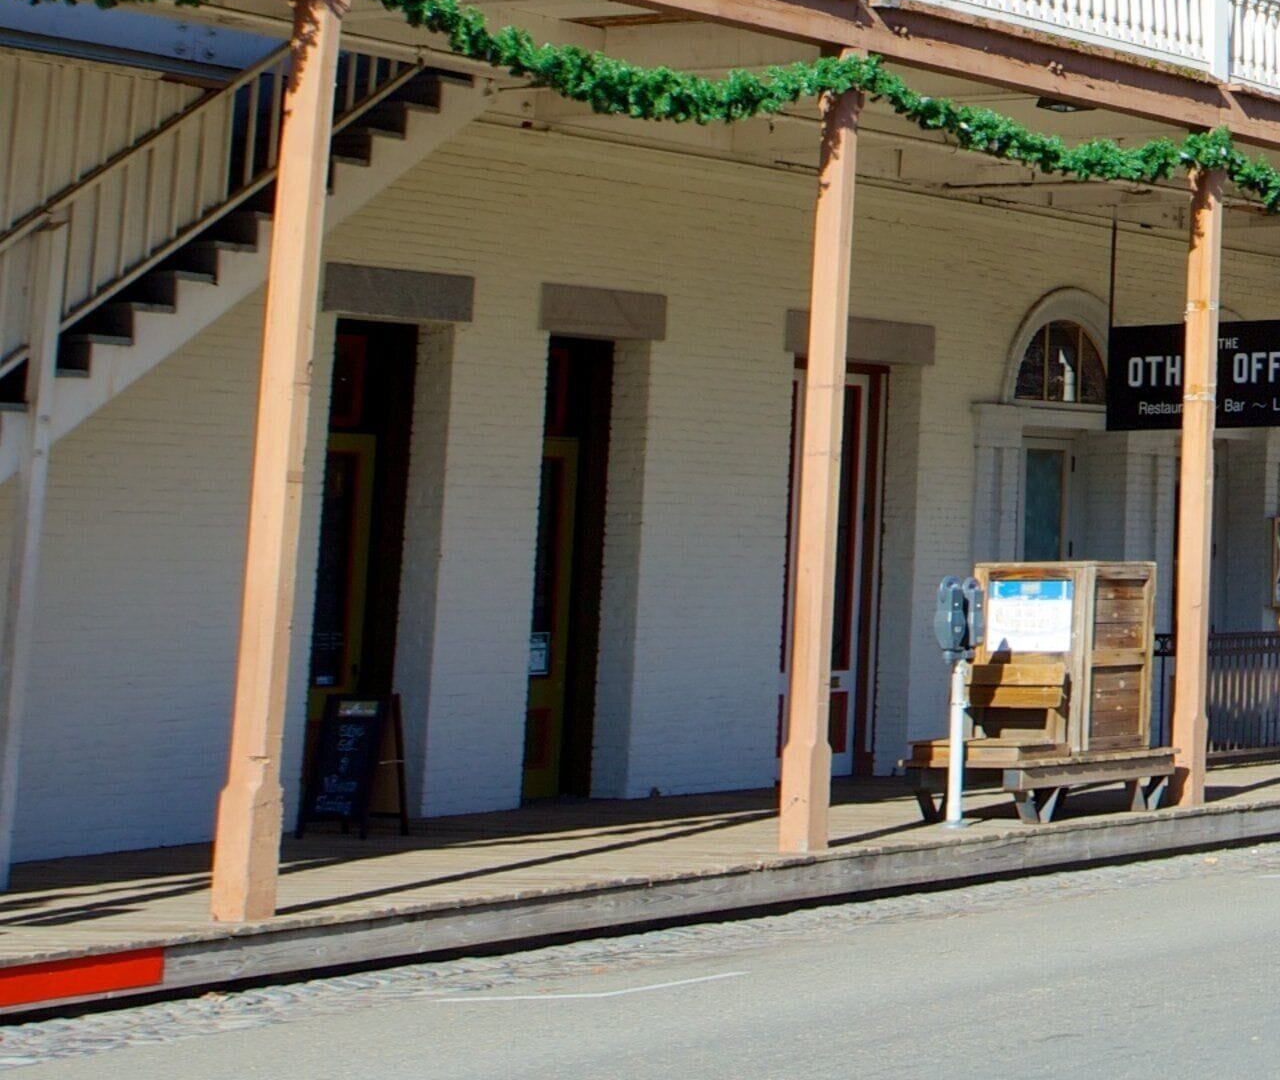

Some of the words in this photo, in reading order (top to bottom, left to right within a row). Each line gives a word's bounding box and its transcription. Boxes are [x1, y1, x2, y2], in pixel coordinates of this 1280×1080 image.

[1218, 337, 1239, 350] THE
[1127, 355, 1181, 388] OTH
[1224, 398, 1245, 413] Bar
